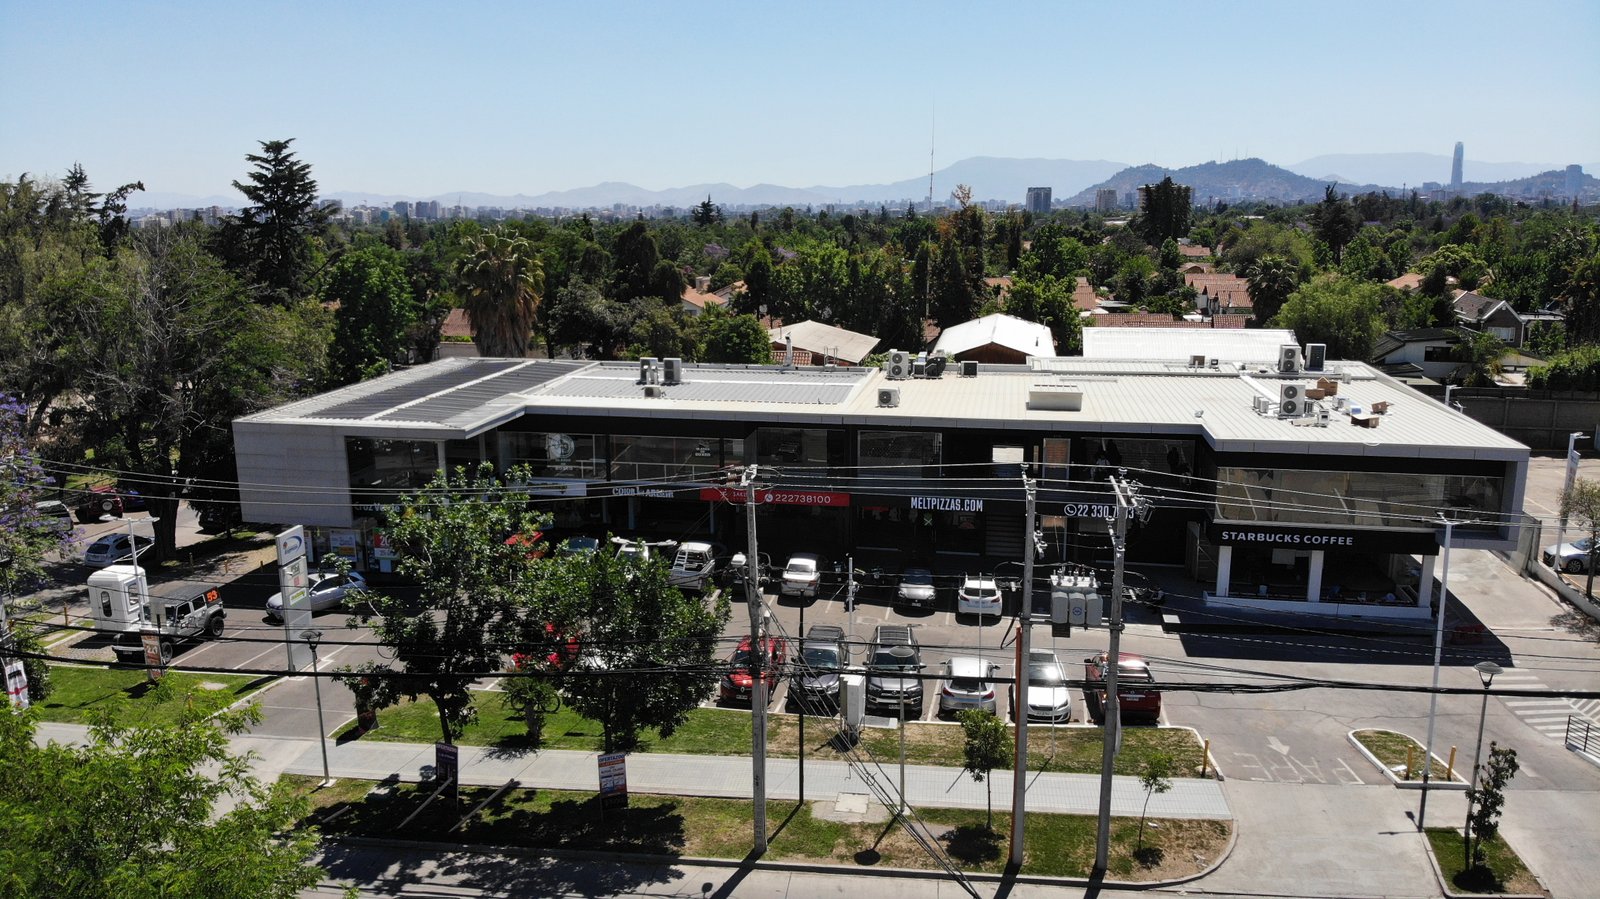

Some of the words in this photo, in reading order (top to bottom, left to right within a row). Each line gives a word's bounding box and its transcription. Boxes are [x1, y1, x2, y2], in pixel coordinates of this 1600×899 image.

[775, 493, 831, 504] 222738100
[911, 497, 983, 512] MELTPIZZAS.COM
[1078, 504, 1088, 517] 22
[1091, 505, 1109, 518] 330
[1221, 531, 1300, 543] STARBUCKS
[1303, 535, 1353, 545] COFFEE
[1233, 752, 1364, 785] PARE
